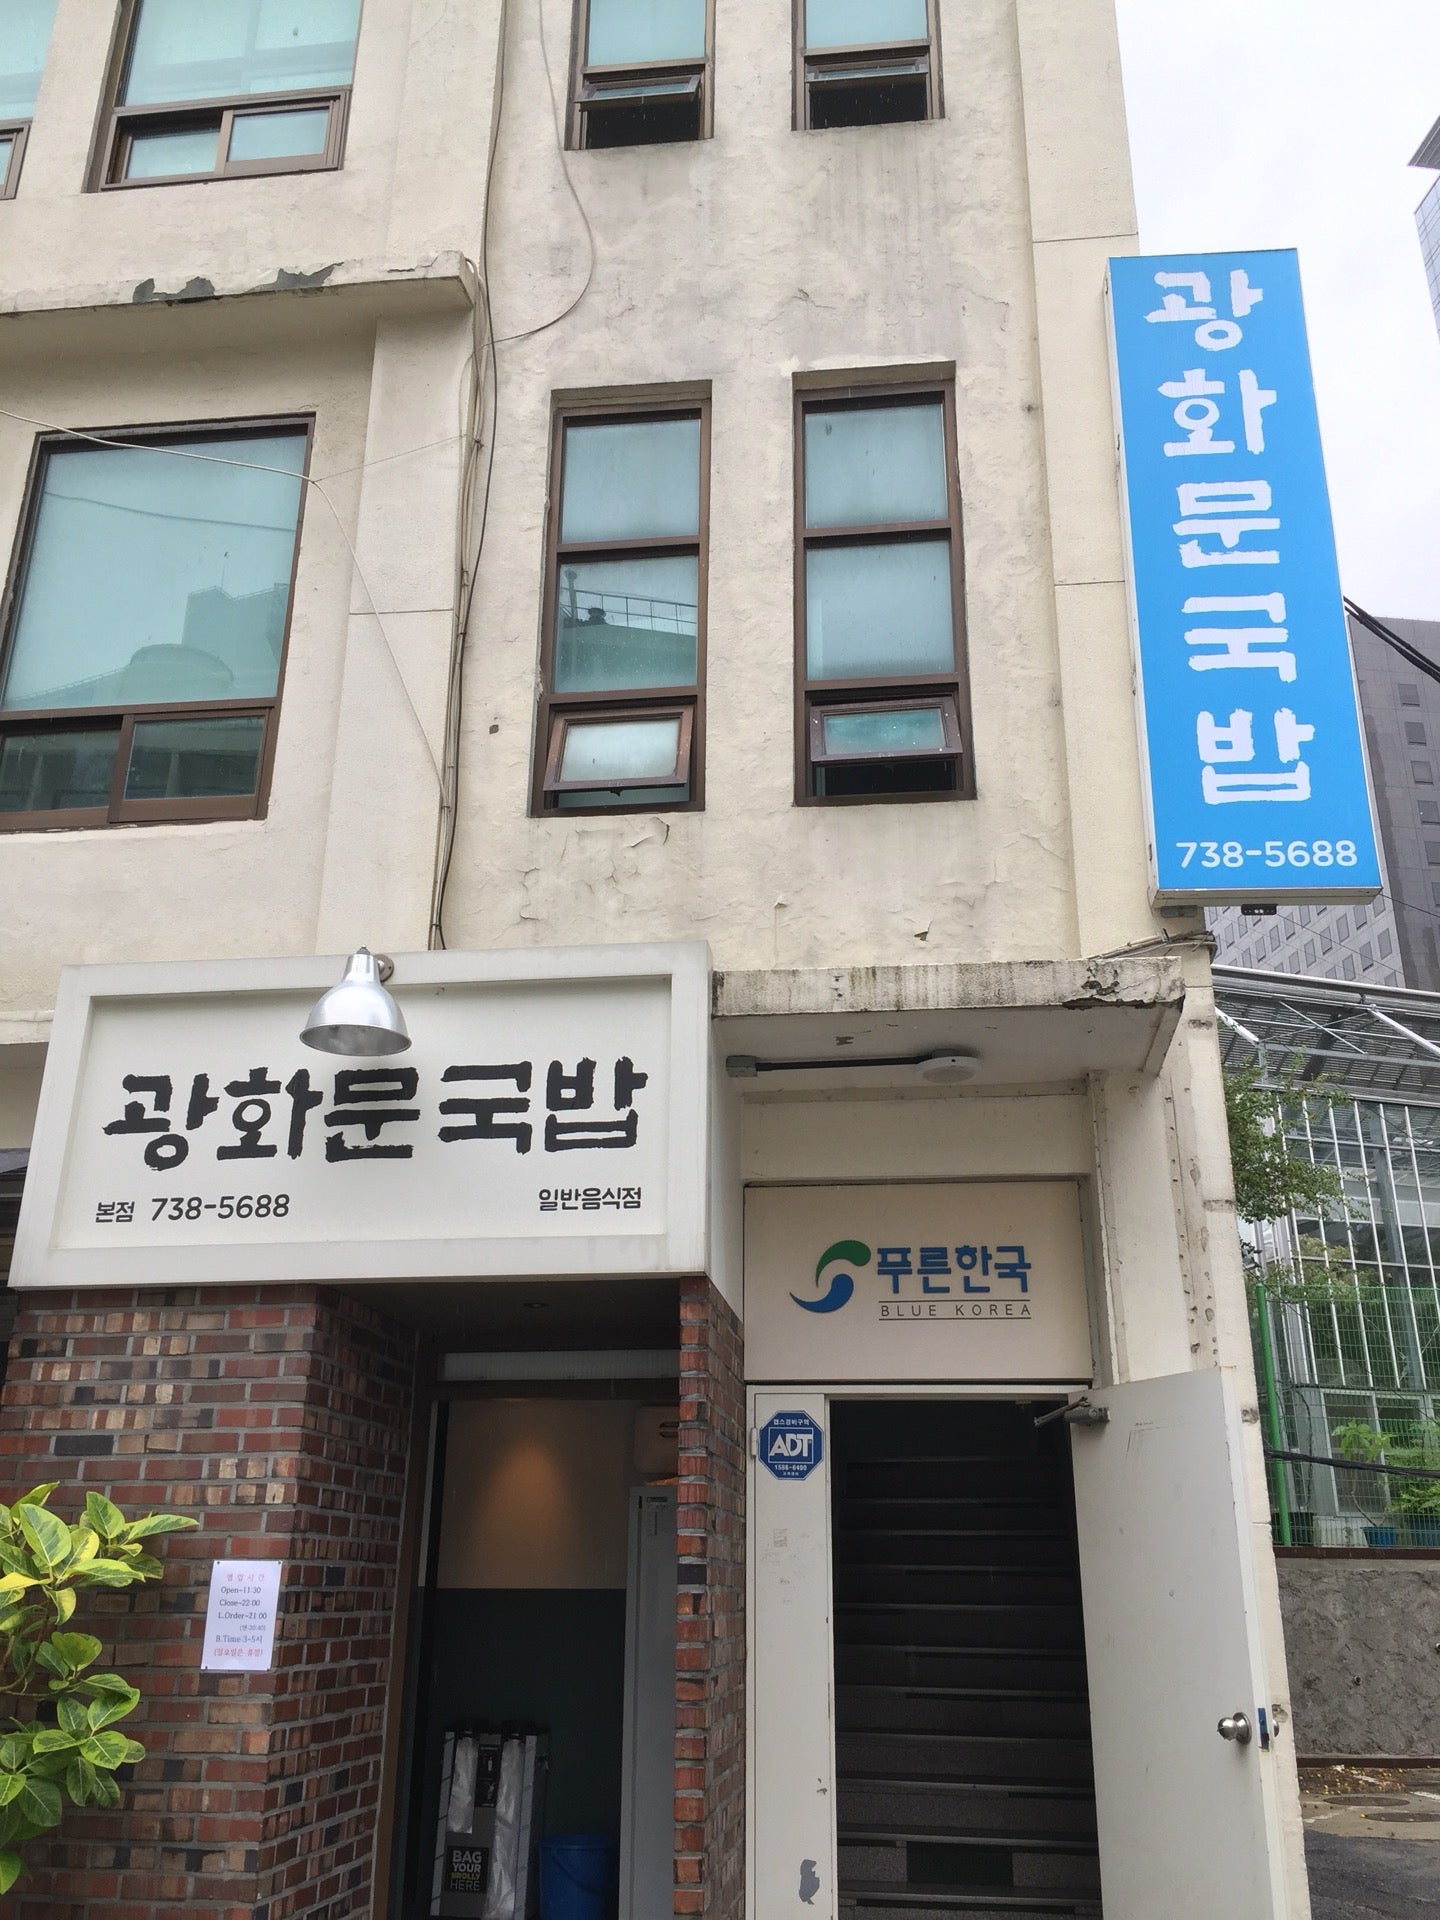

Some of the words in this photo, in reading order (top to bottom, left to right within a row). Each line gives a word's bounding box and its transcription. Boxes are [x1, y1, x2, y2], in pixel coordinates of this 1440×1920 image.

[1143, 269, 1315, 806] 광화문국밥
[1175, 840, 1358, 869] 738-5688
[102, 1056, 648, 1171] 광화문국밥
[95, 1201, 136, 1224] 본점
[150, 1194, 291, 1222] 738-5688
[538, 1187, 643, 1211] 일반음식점
[877, 1245, 1031, 1294] 푸른한국
[881, 1305, 937, 1317] BLUE
[955, 1304, 1031, 1317] KOREA
[768, 1433, 813, 1457] ADT
[452, 1850, 482, 1864] BAG
[452, 1862, 482, 1873] YOUR
[450, 1880, 480, 1891] HERE
